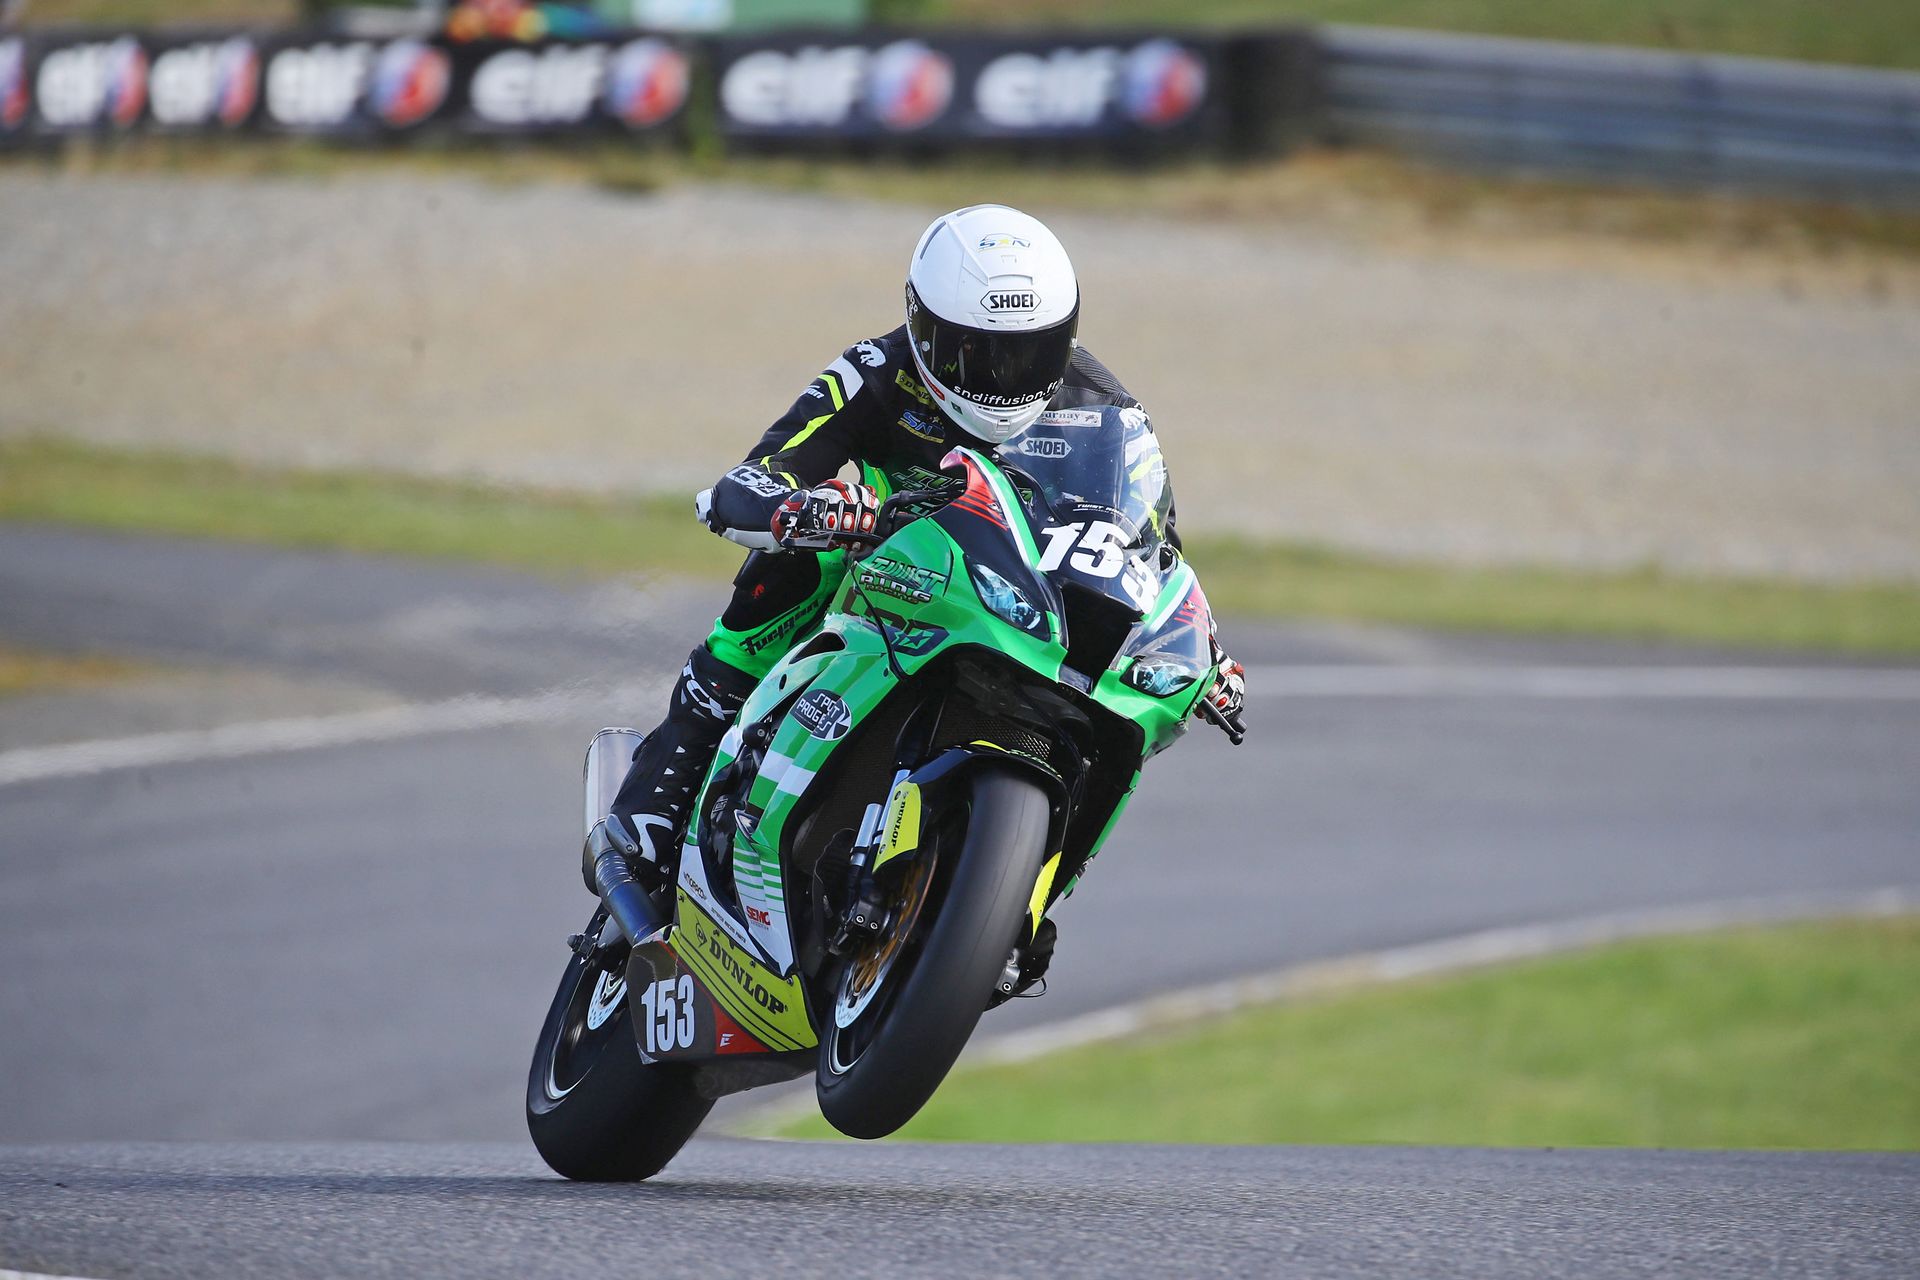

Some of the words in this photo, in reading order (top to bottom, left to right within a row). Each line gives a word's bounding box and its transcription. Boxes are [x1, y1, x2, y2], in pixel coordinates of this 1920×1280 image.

[989, 294, 1034, 309] SHOEI
[1024, 440, 1066, 455] SHOEI
[1036, 520, 1159, 614] 153
[891, 800, 906, 848] DUNLOP
[708, 938, 784, 1015] DUNLOP
[641, 974, 695, 1053] 153
